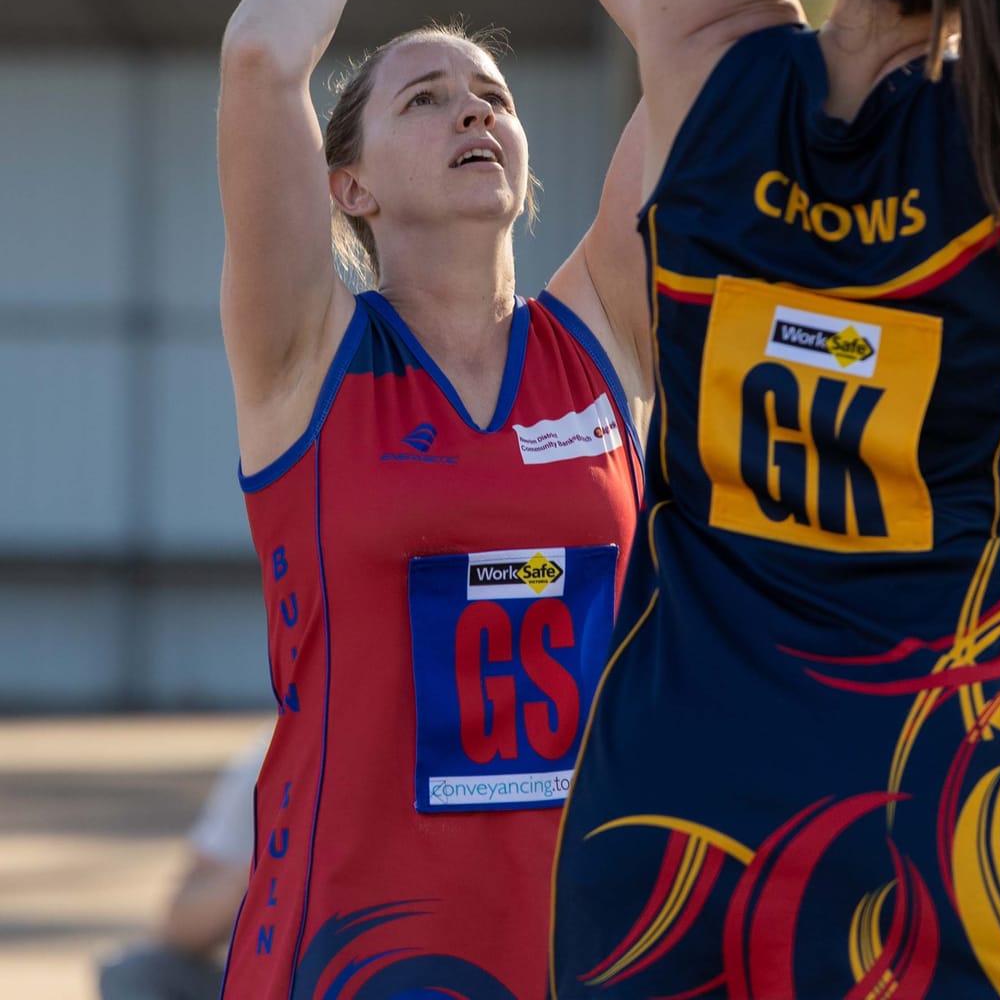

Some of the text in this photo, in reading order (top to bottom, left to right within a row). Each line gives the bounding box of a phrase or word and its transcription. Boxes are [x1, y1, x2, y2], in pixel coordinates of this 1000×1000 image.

[754, 170, 927, 244] CROWS
[739, 361, 888, 538] GK
[455, 597, 580, 765] GS
